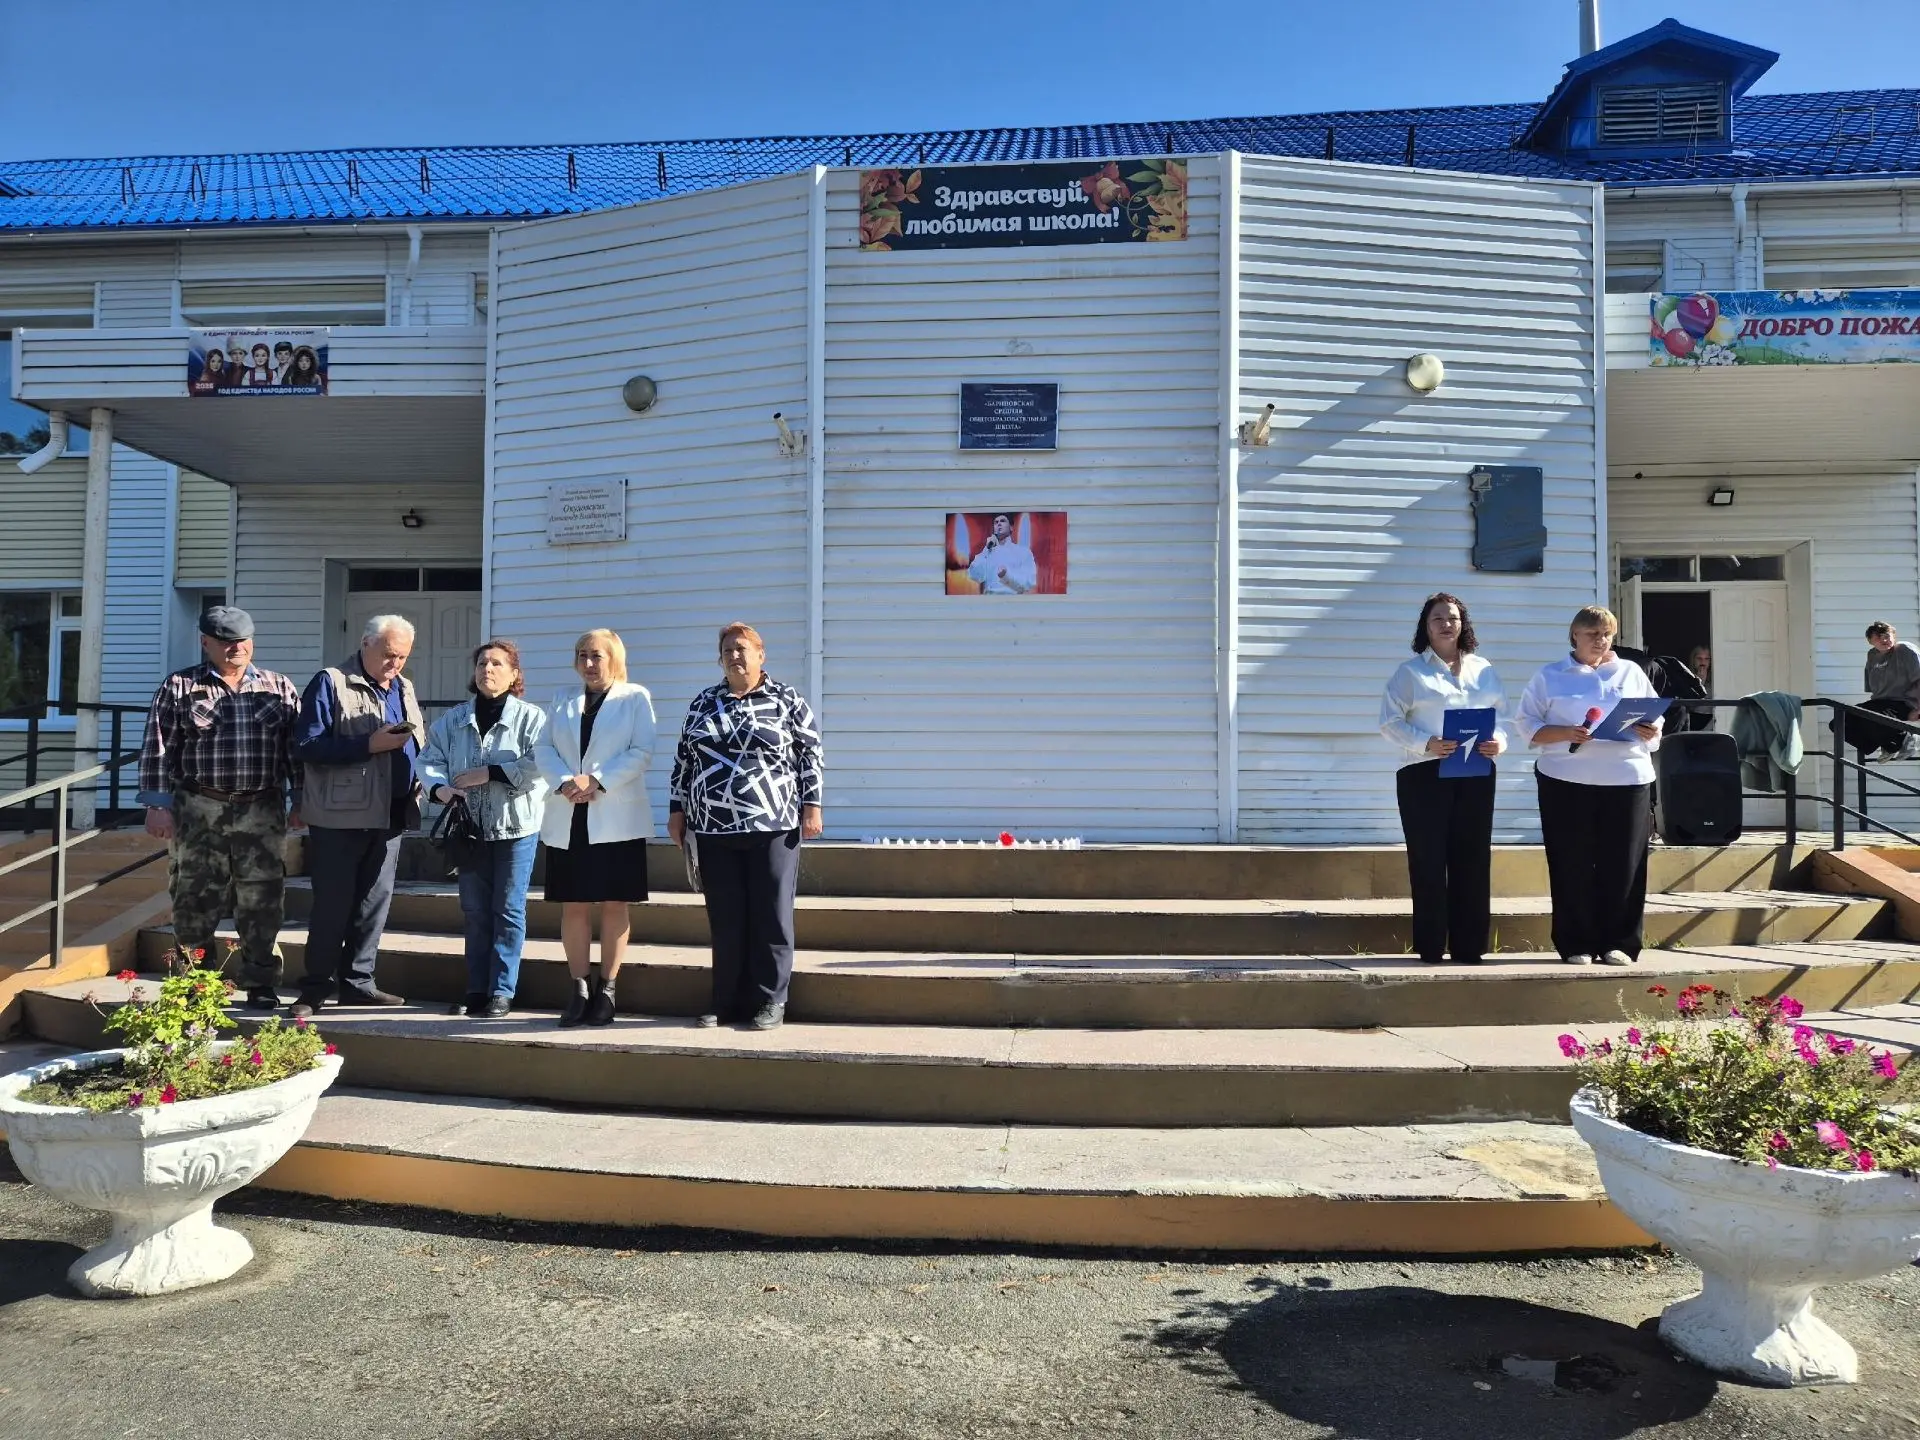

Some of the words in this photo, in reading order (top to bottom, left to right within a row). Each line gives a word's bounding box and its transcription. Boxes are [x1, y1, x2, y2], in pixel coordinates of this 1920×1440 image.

[934, 180, 1090, 211] Здравствуй,
[905, 212, 1021, 235] любимая
[1029, 206, 1120, 231] школа!
[1738, 317, 1834, 339] ДОБРО
[218, 387, 230, 395] ГОД
[230, 387, 262, 395] ЕДИНСТВА
[293, 386, 317, 394] РОССИИ
